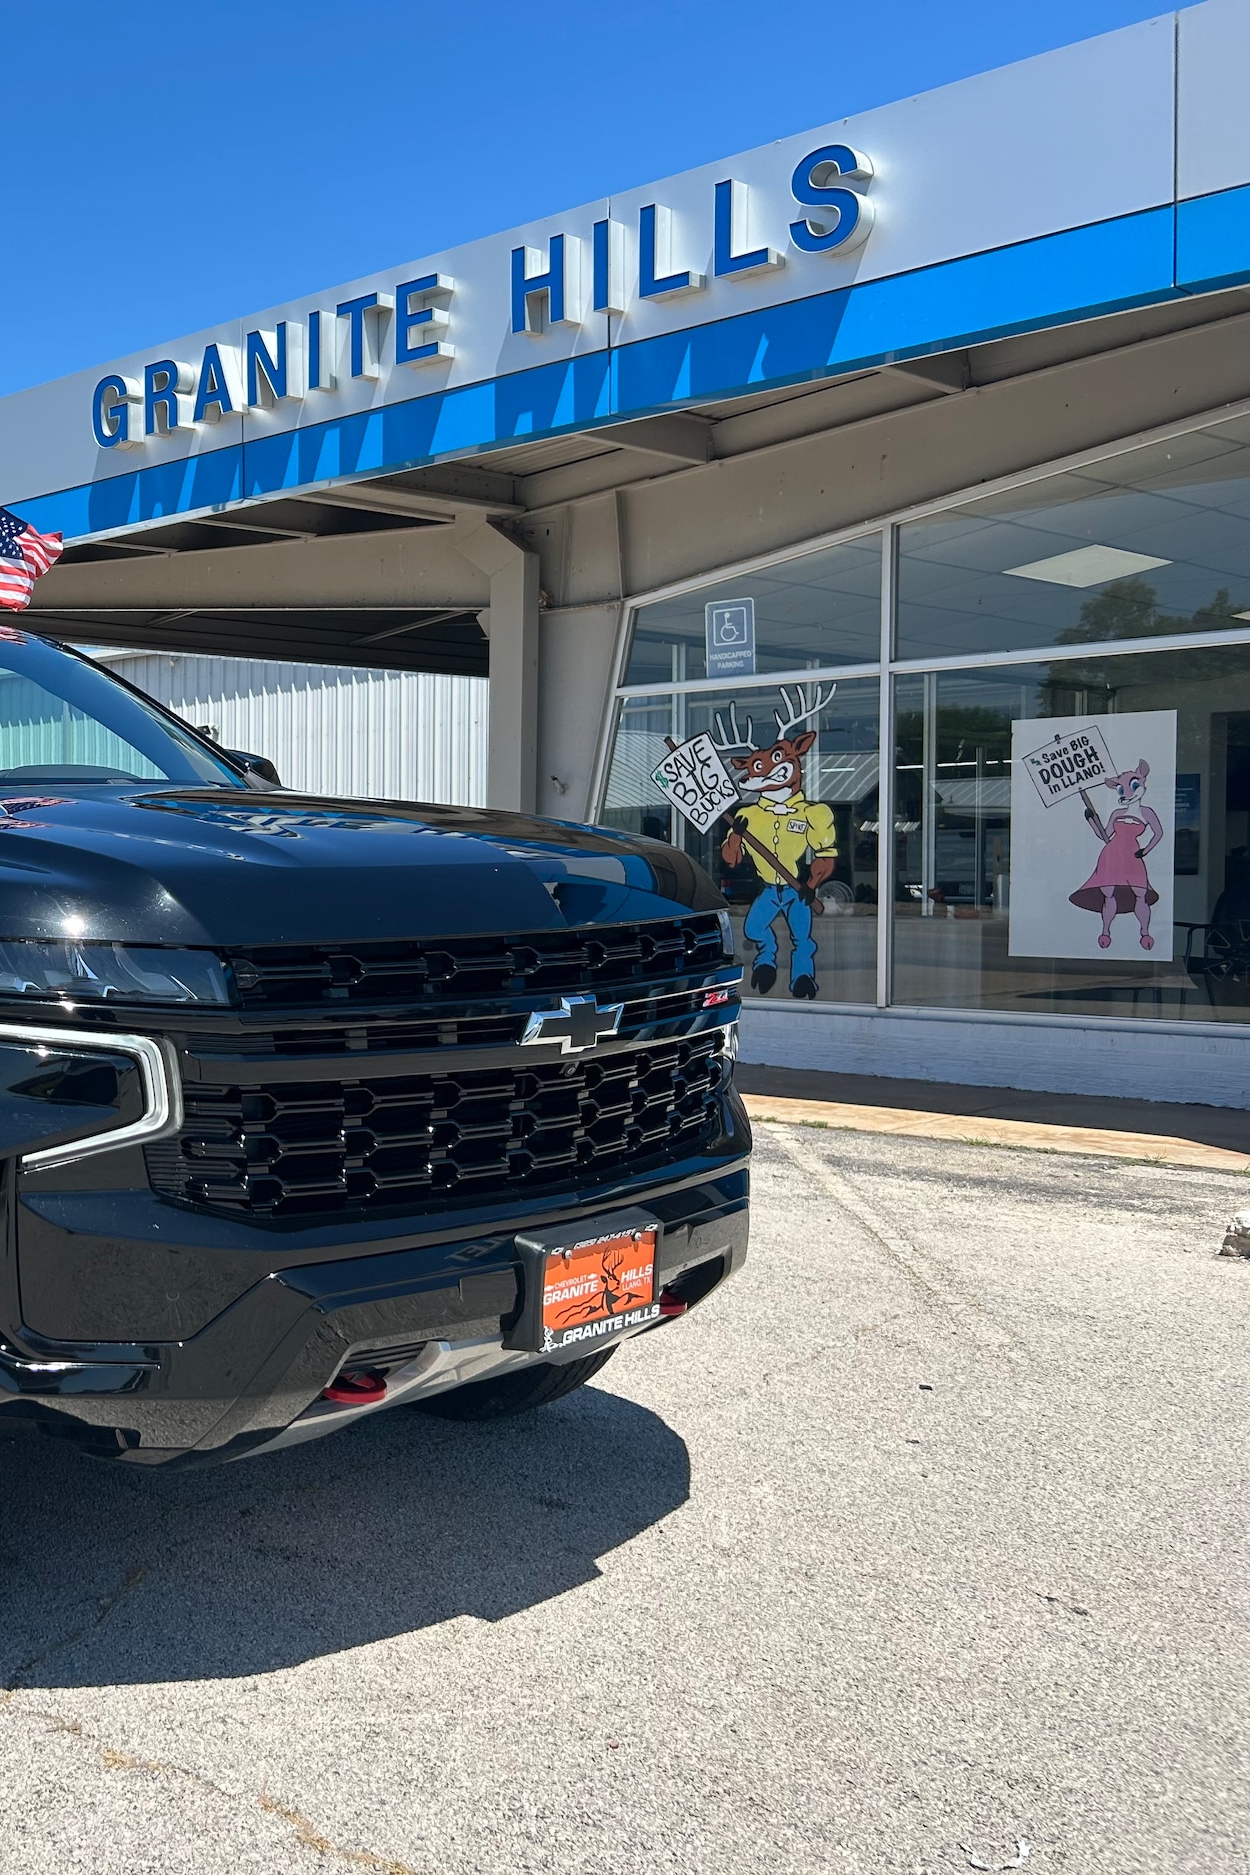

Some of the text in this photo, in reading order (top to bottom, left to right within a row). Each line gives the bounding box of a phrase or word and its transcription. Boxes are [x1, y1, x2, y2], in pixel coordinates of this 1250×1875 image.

[92, 143, 874, 450] GRANITE HILLS
[709, 650, 752, 661] HANDICAPPED
[717, 660, 744, 669] PARKING
[663, 738, 712, 783] SAVE
[1038, 745, 1100, 785] DOUGH
[1041, 747, 1069, 764] Save
[1069, 735, 1090, 751] BIG
[672, 762, 719, 807] BIG
[1047, 761, 1106, 795] in LLANO!
[689, 778, 735, 826] BUCKS
[543, 1263, 654, 1306] GRANITE HILLS
[554, 1274, 588, 1290] CHEVROLET
[643, 1276, 651, 1285] TX
[562, 1304, 661, 1345] GRANITE HILLS
